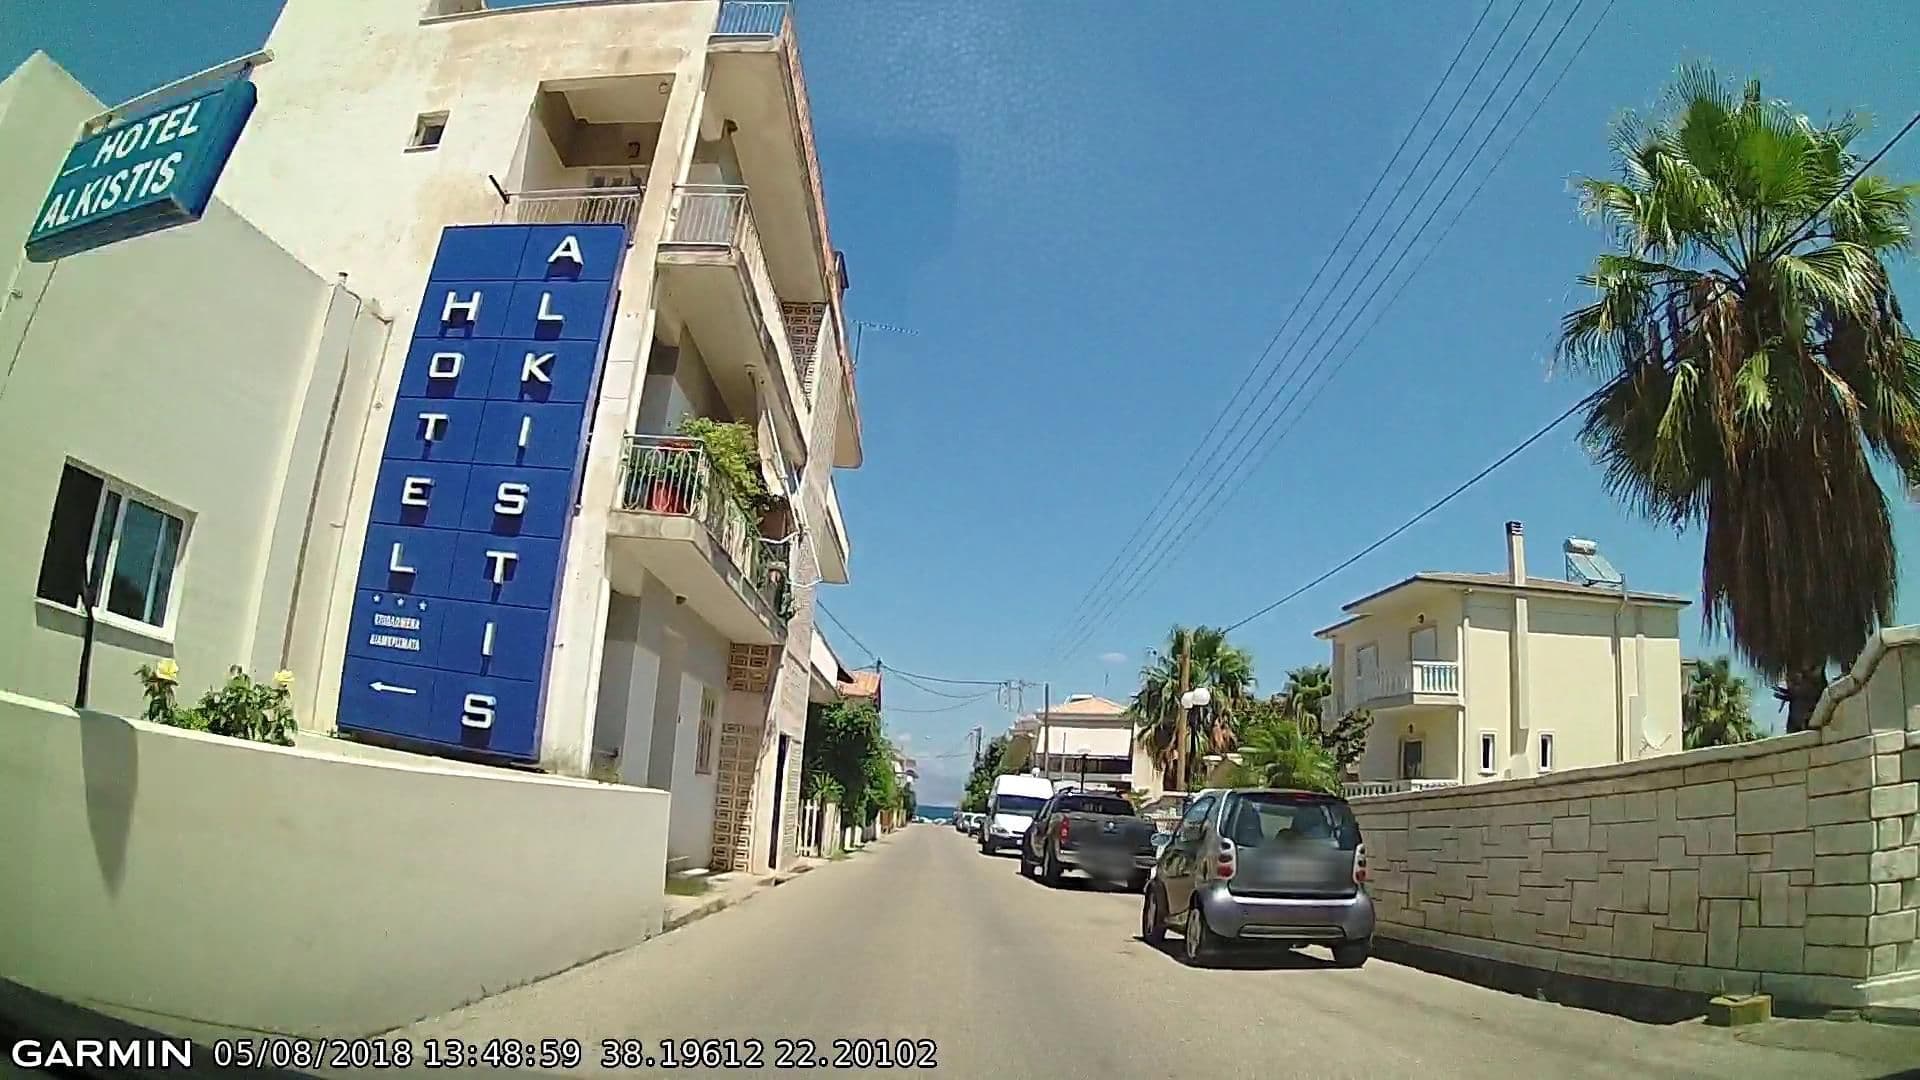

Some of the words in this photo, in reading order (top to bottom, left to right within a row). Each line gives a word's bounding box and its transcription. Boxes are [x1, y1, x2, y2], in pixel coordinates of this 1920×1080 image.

[38, 151, 182, 232] ALKISTIS
[93, 100, 201, 167] HOTEL
[389, 291, 482, 573] HOTEL
[461, 235, 584, 729] ALKISTIS
